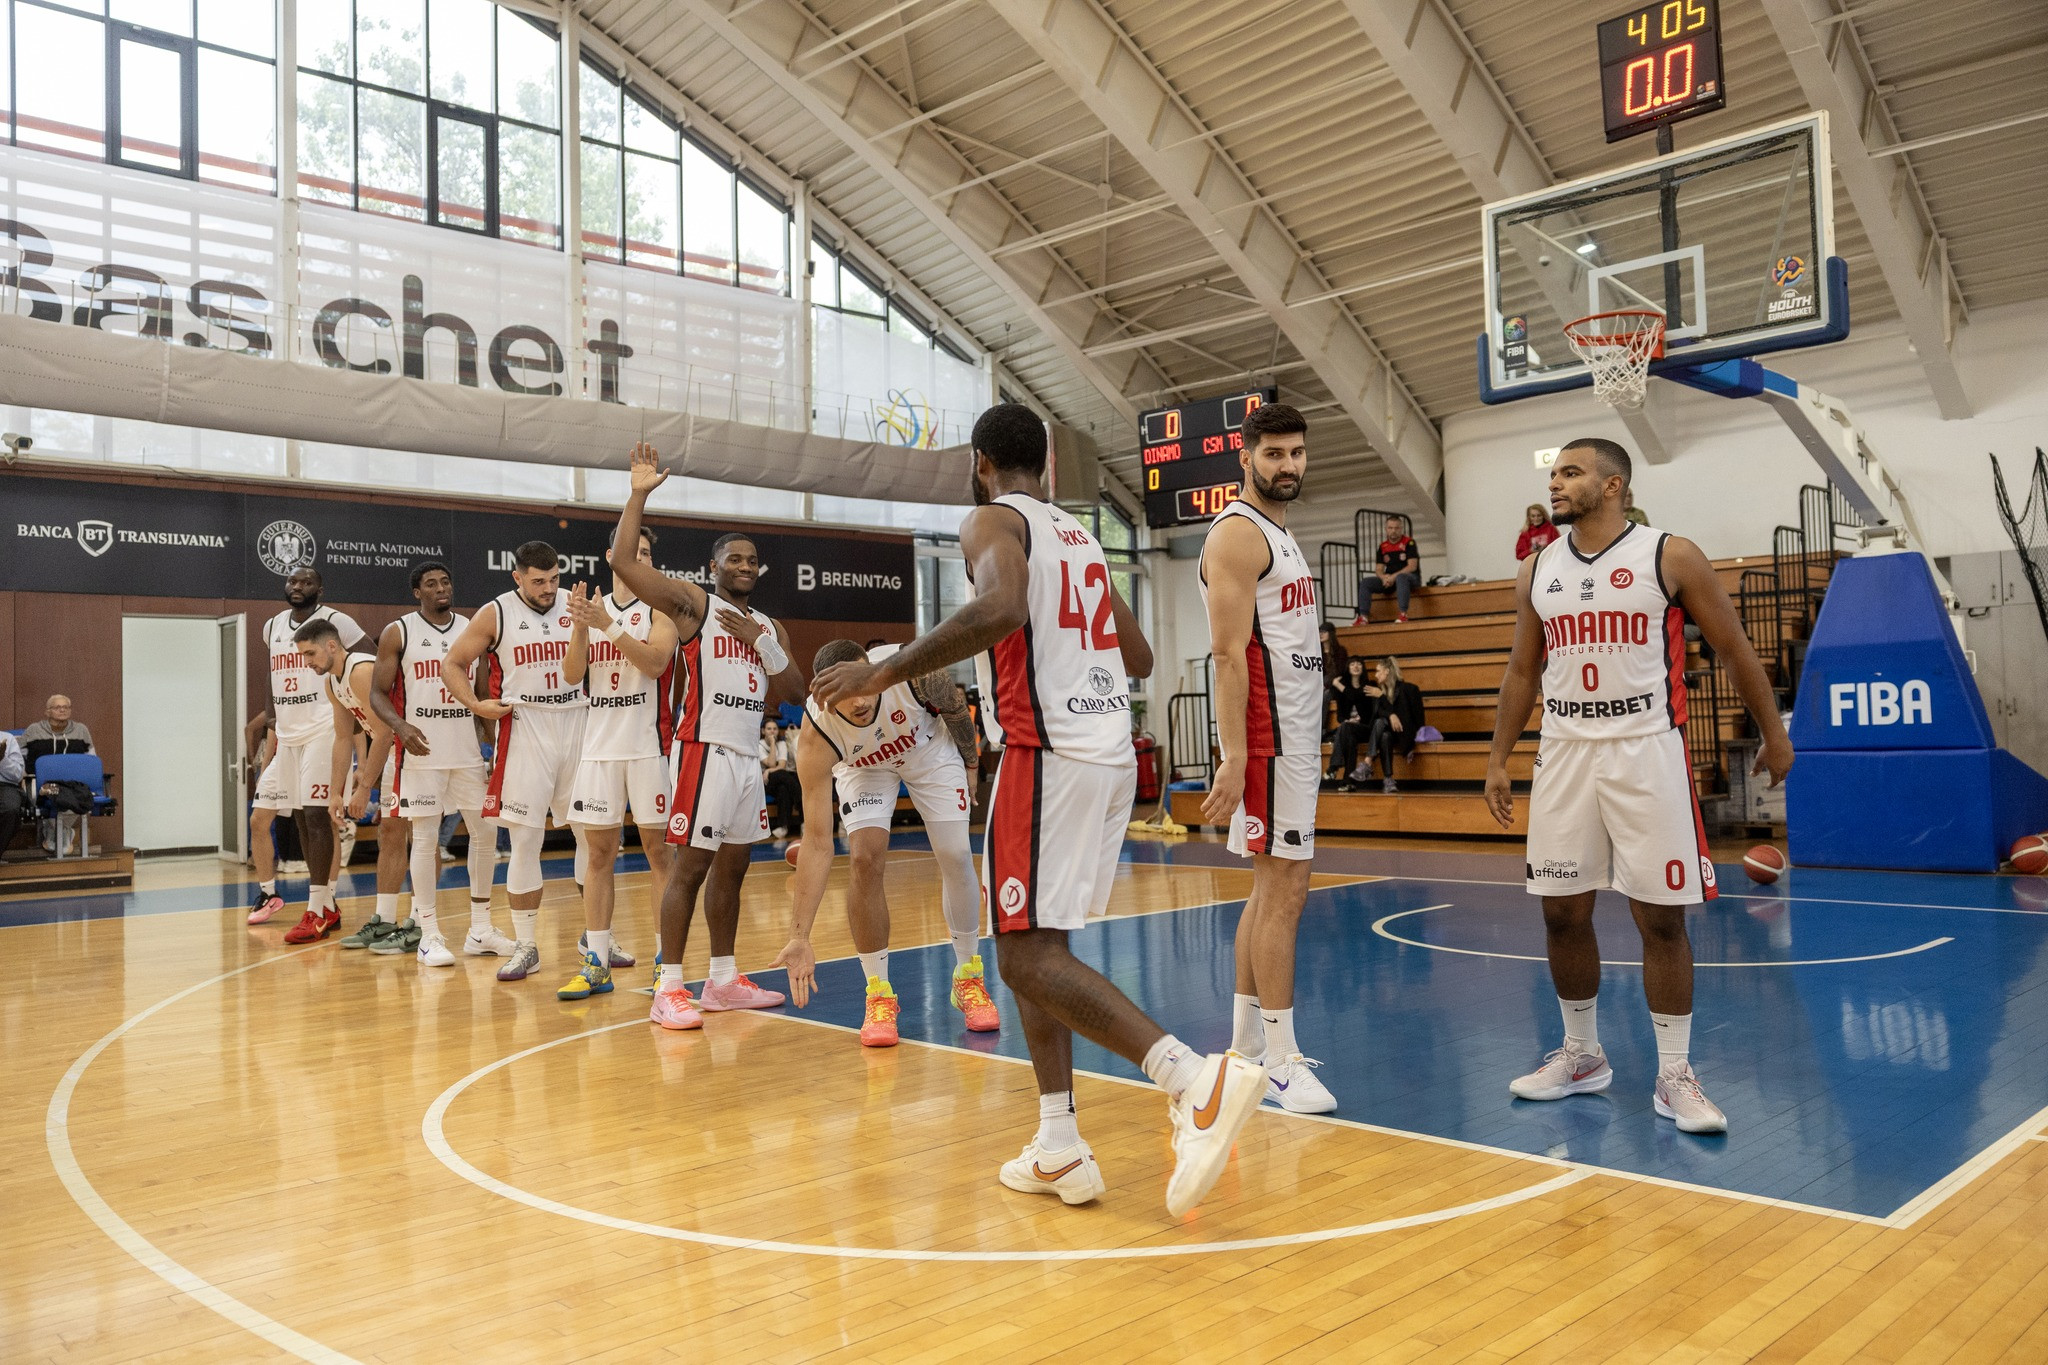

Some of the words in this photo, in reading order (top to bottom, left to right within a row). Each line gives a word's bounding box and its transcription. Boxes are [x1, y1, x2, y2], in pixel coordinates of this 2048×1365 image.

[1624, 43, 1694, 116] 0.0
[1767, 306, 1813, 322] EUROBASKET
[1768, 295, 1813, 313] YOUTH
[1506, 345, 1526, 358] FIBA
[1165, 411, 1179, 438] 0
[1144, 444, 1182, 465] DINAMO
[1202, 435, 1225, 455] CSM
[1148, 468, 1160, 490] 0
[17, 523, 73, 539] BANCA
[85, 528, 106, 541] BT
[261, 522, 311, 544] GUVERNUL
[487, 549, 600, 576] LINOFT
[821, 571, 902, 590] BRENNTAG
[1058, 559, 1120, 651] 42
[1543, 610, 1649, 652] DINAMO
[284, 677, 298, 693] 23
[544, 671, 559, 690] 11
[611, 672, 620, 691] 9
[748, 672, 758, 693] 5
[1581, 662, 1599, 692] 0
[272, 692, 319, 706] SUPERBET
[1546, 692, 1655, 719] SUPERBET
[1829, 679, 1933, 727] FIBA
[415, 707, 472, 719] SUPERBE
[310, 784, 330, 800] 23
[956, 788, 967, 811] 3
[655, 794, 666, 814] 9
[851, 797, 883, 808] affidea
[759, 808, 768, 830] 5
[1534, 868, 1579, 879] affidea
[1544, 859, 1578, 868] Clinicile
[1665, 859, 1686, 891] 0
